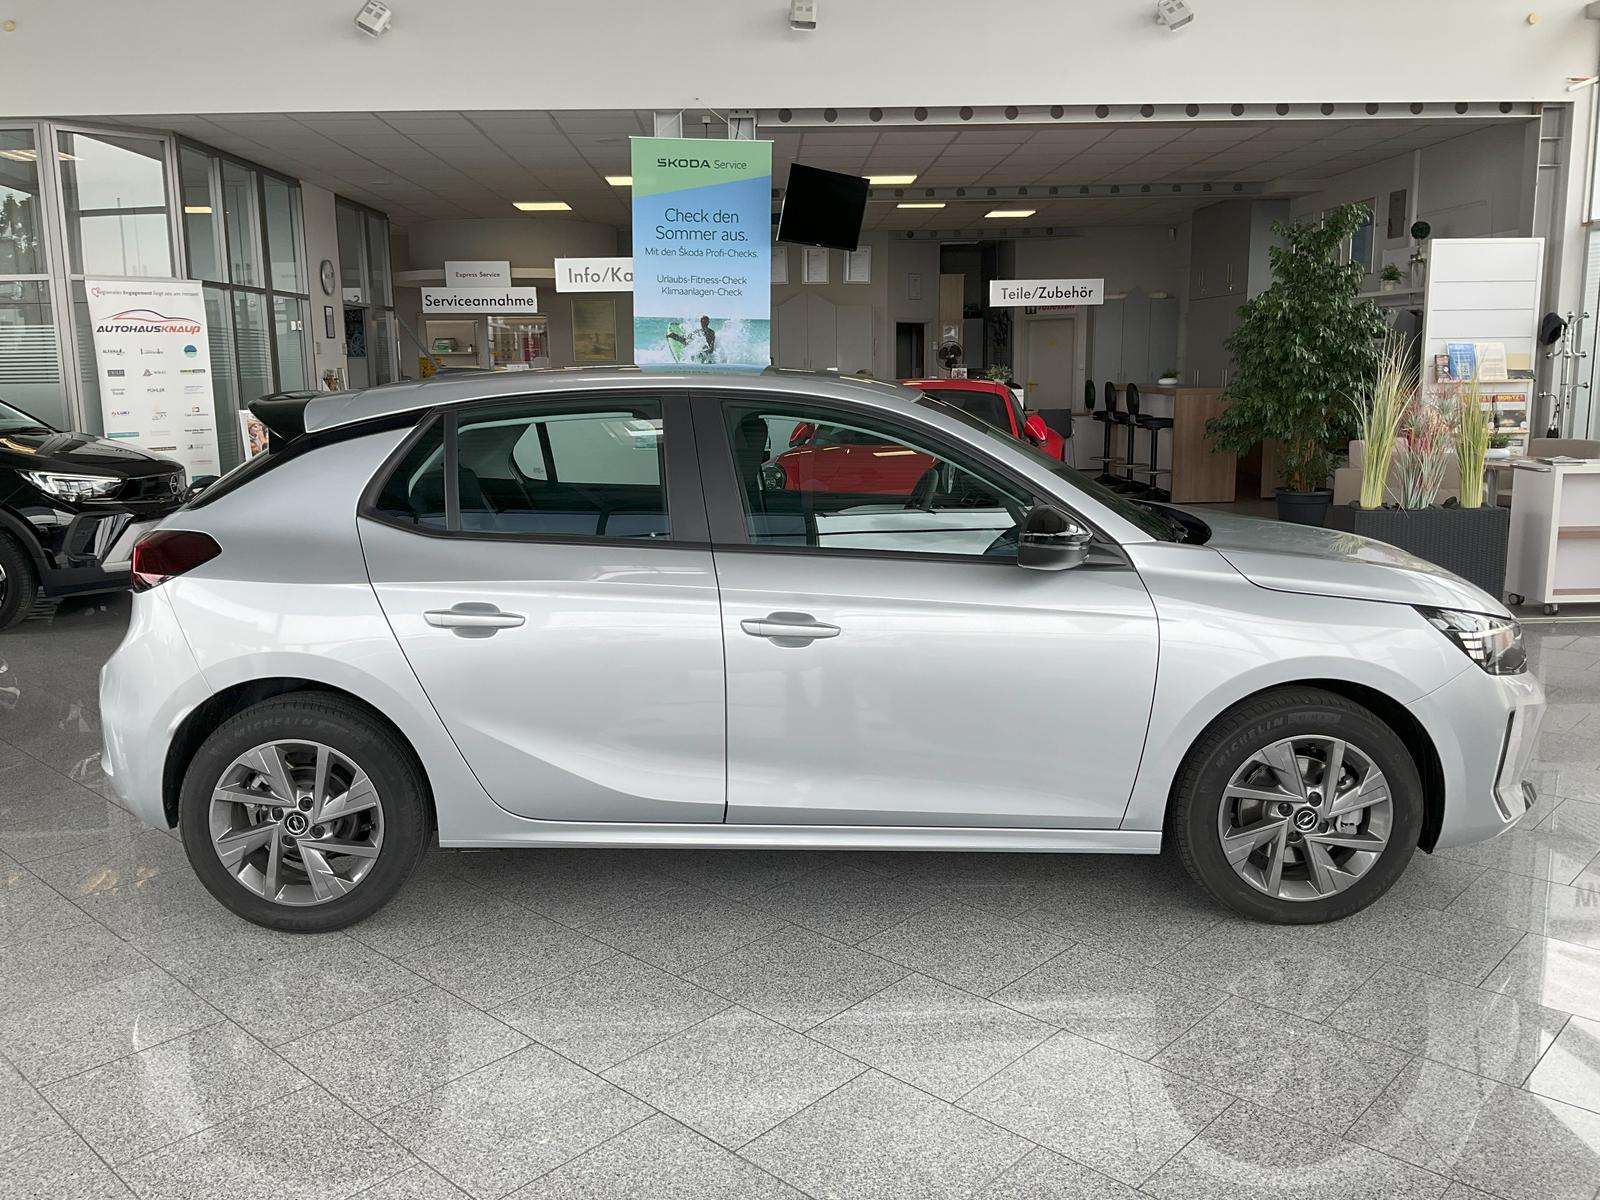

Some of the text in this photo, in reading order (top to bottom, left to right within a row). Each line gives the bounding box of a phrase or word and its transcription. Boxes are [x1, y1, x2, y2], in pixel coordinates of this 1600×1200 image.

[713, 160, 748, 170] Service
[664, 207, 740, 224] Check den
[655, 225, 749, 242] Sommer aus.
[645, 245, 759, 259] Mit den Škoda Profi-Checks.
[455, 271, 478, 279] Express
[567, 266, 633, 284] Info/Ka
[656, 274, 748, 285] Urlaubs-Fitness-Check
[661, 286, 743, 298] Klimaanlagen-Check
[1000, 285, 1094, 300] Teile/Zubehör
[424, 293, 534, 308] Serviceannahme
